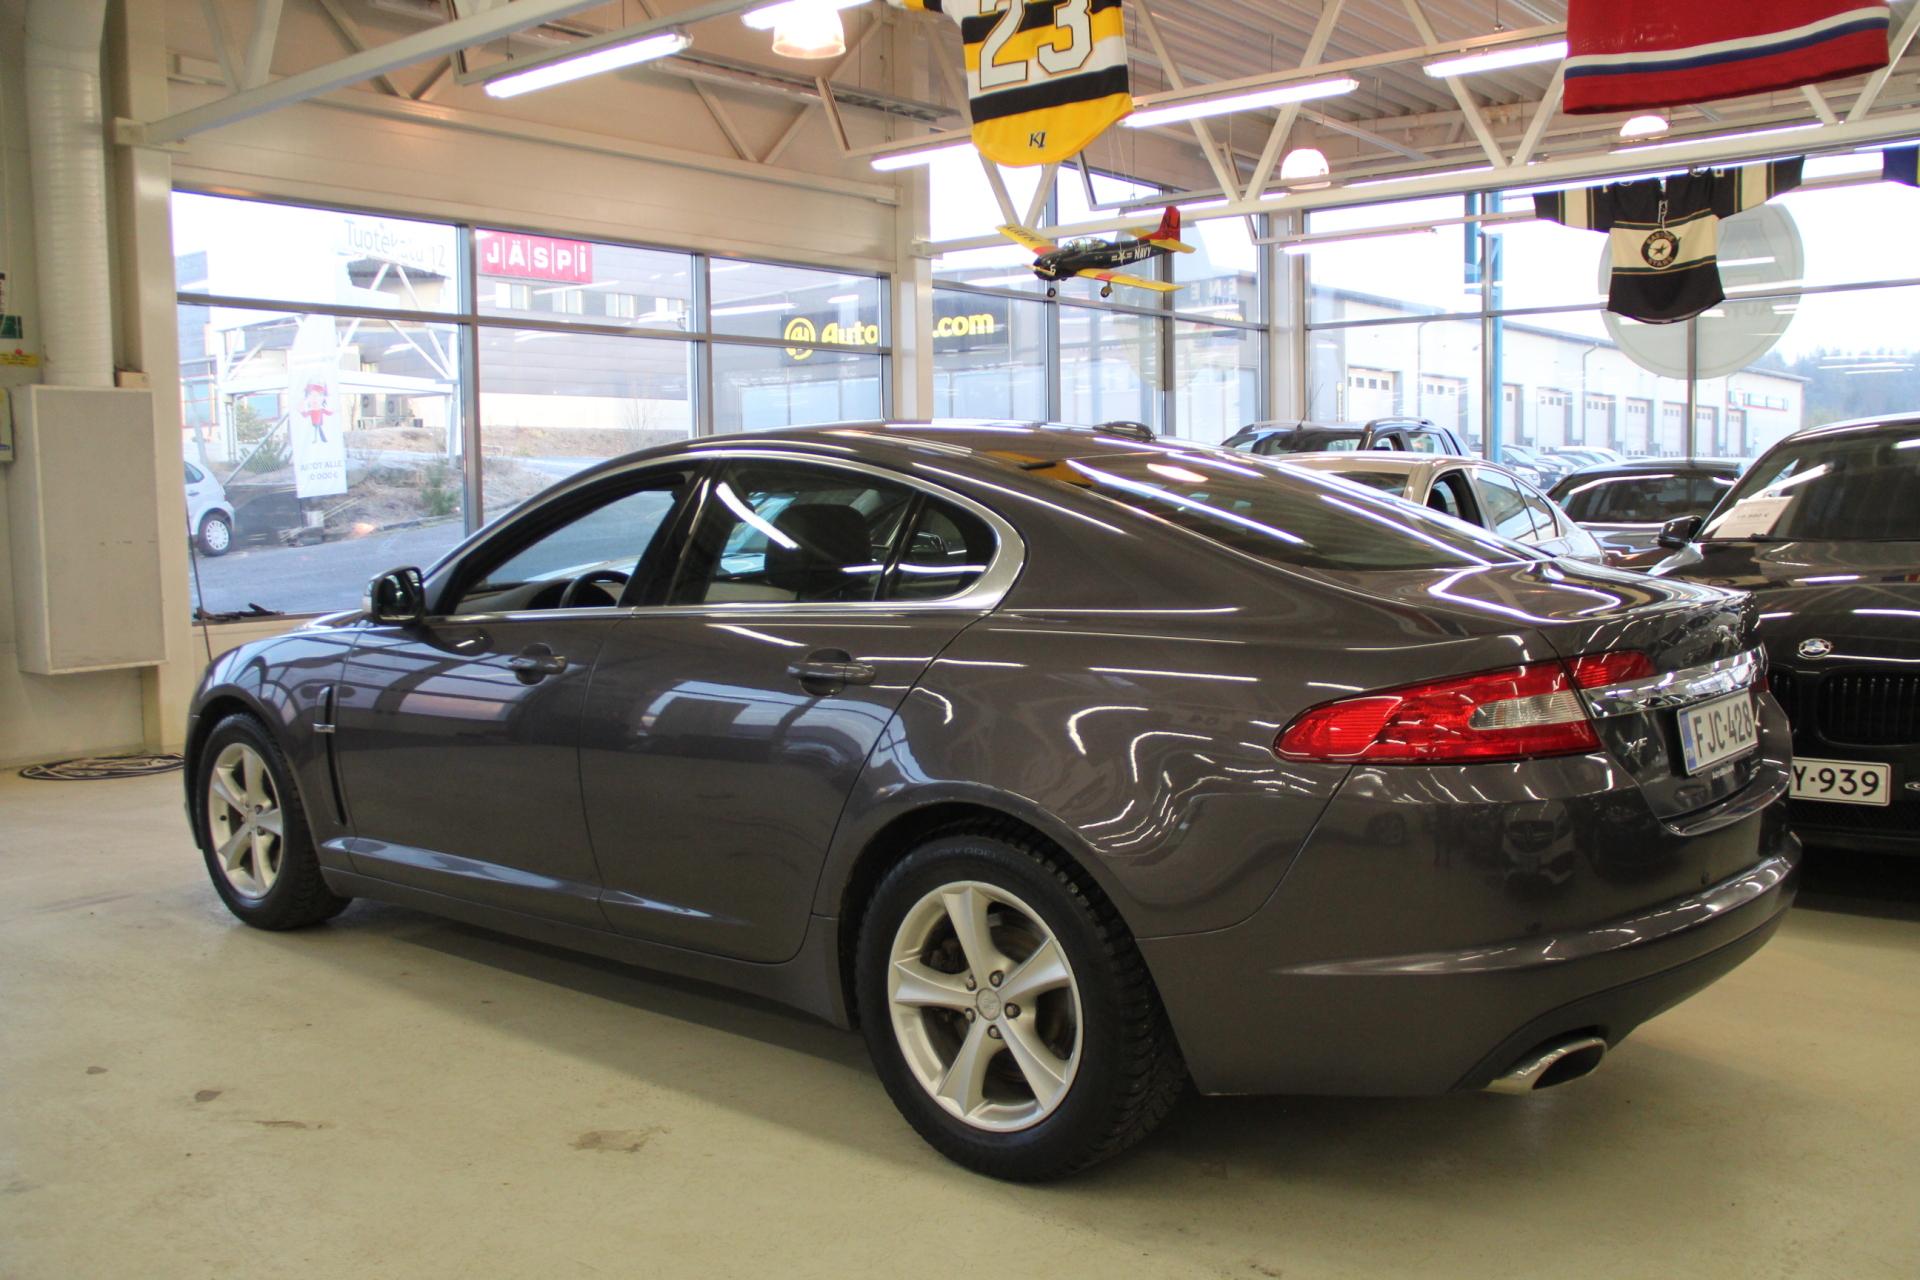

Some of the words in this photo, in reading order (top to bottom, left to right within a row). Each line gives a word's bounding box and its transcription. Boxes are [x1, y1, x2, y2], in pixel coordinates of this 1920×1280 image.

[979, 0, 1093, 90] 23
[1134, 244, 1152, 260] NAVY
[1692, 701, 1753, 758] FJC-428
[1792, 765, 1880, 796] Y-939
